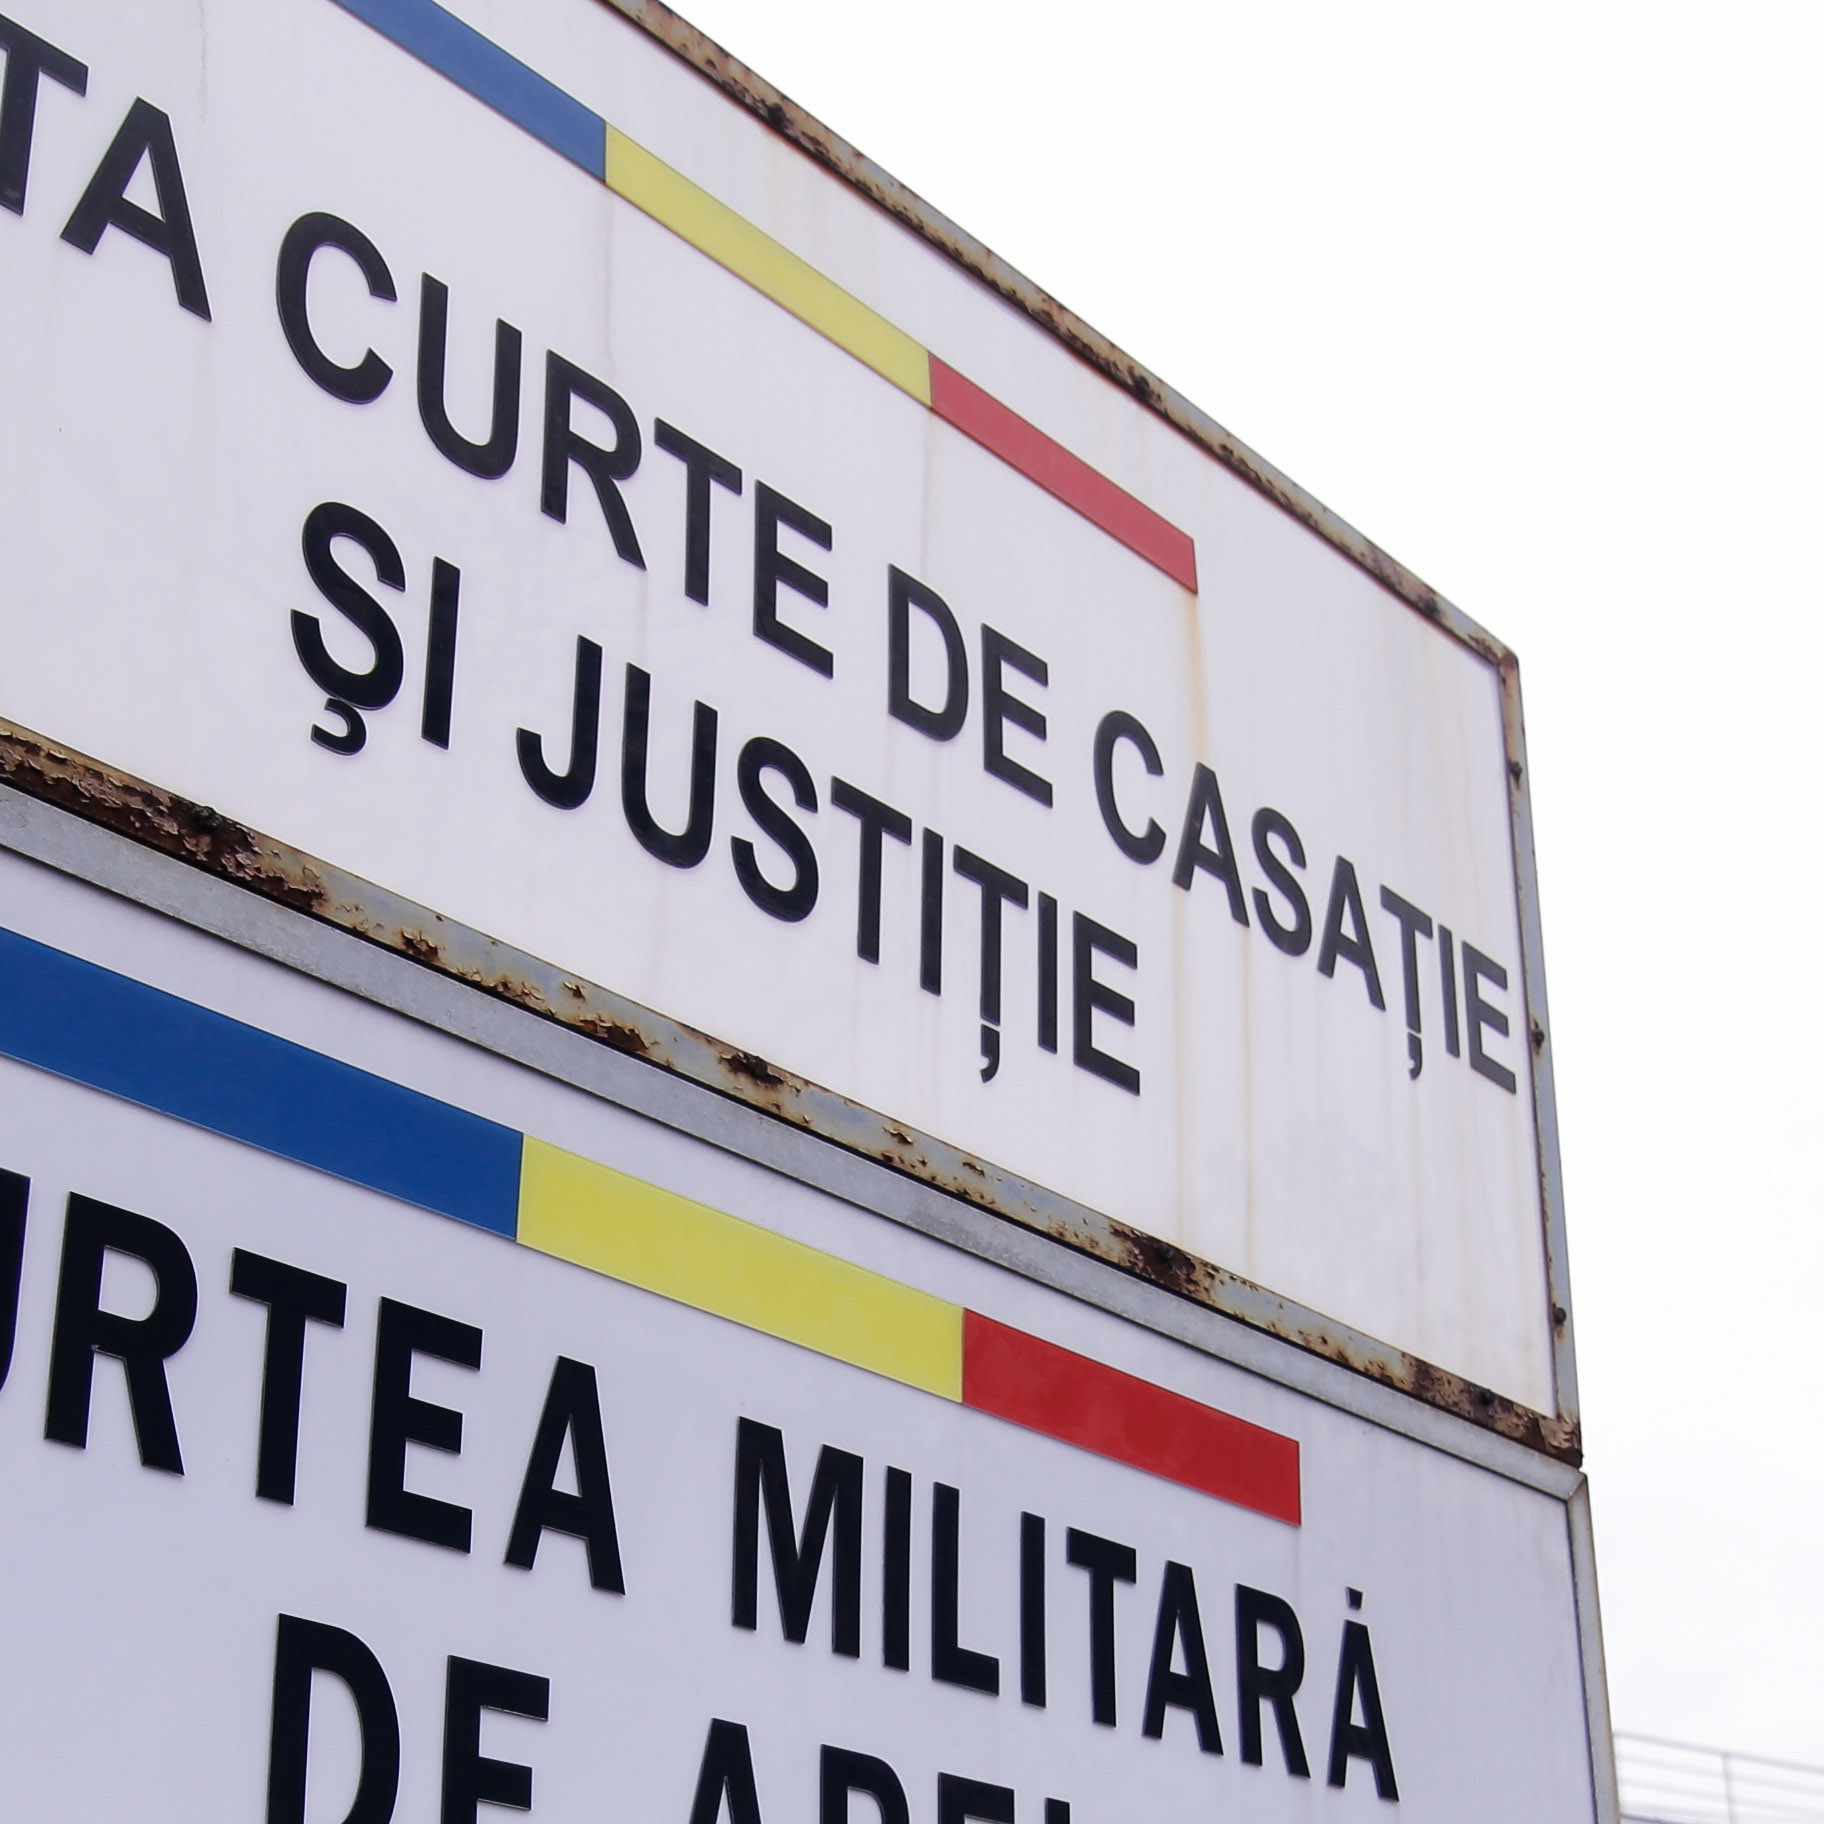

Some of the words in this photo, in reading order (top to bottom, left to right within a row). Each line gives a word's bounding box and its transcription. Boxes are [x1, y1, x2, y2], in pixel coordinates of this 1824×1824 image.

[275, 211, 834, 678] CURTE
[888, 564, 1053, 808] DE
[1094, 710, 1517, 1095] CASAȚIE
[515, 634, 1141, 1096] JUSTIȚIE
